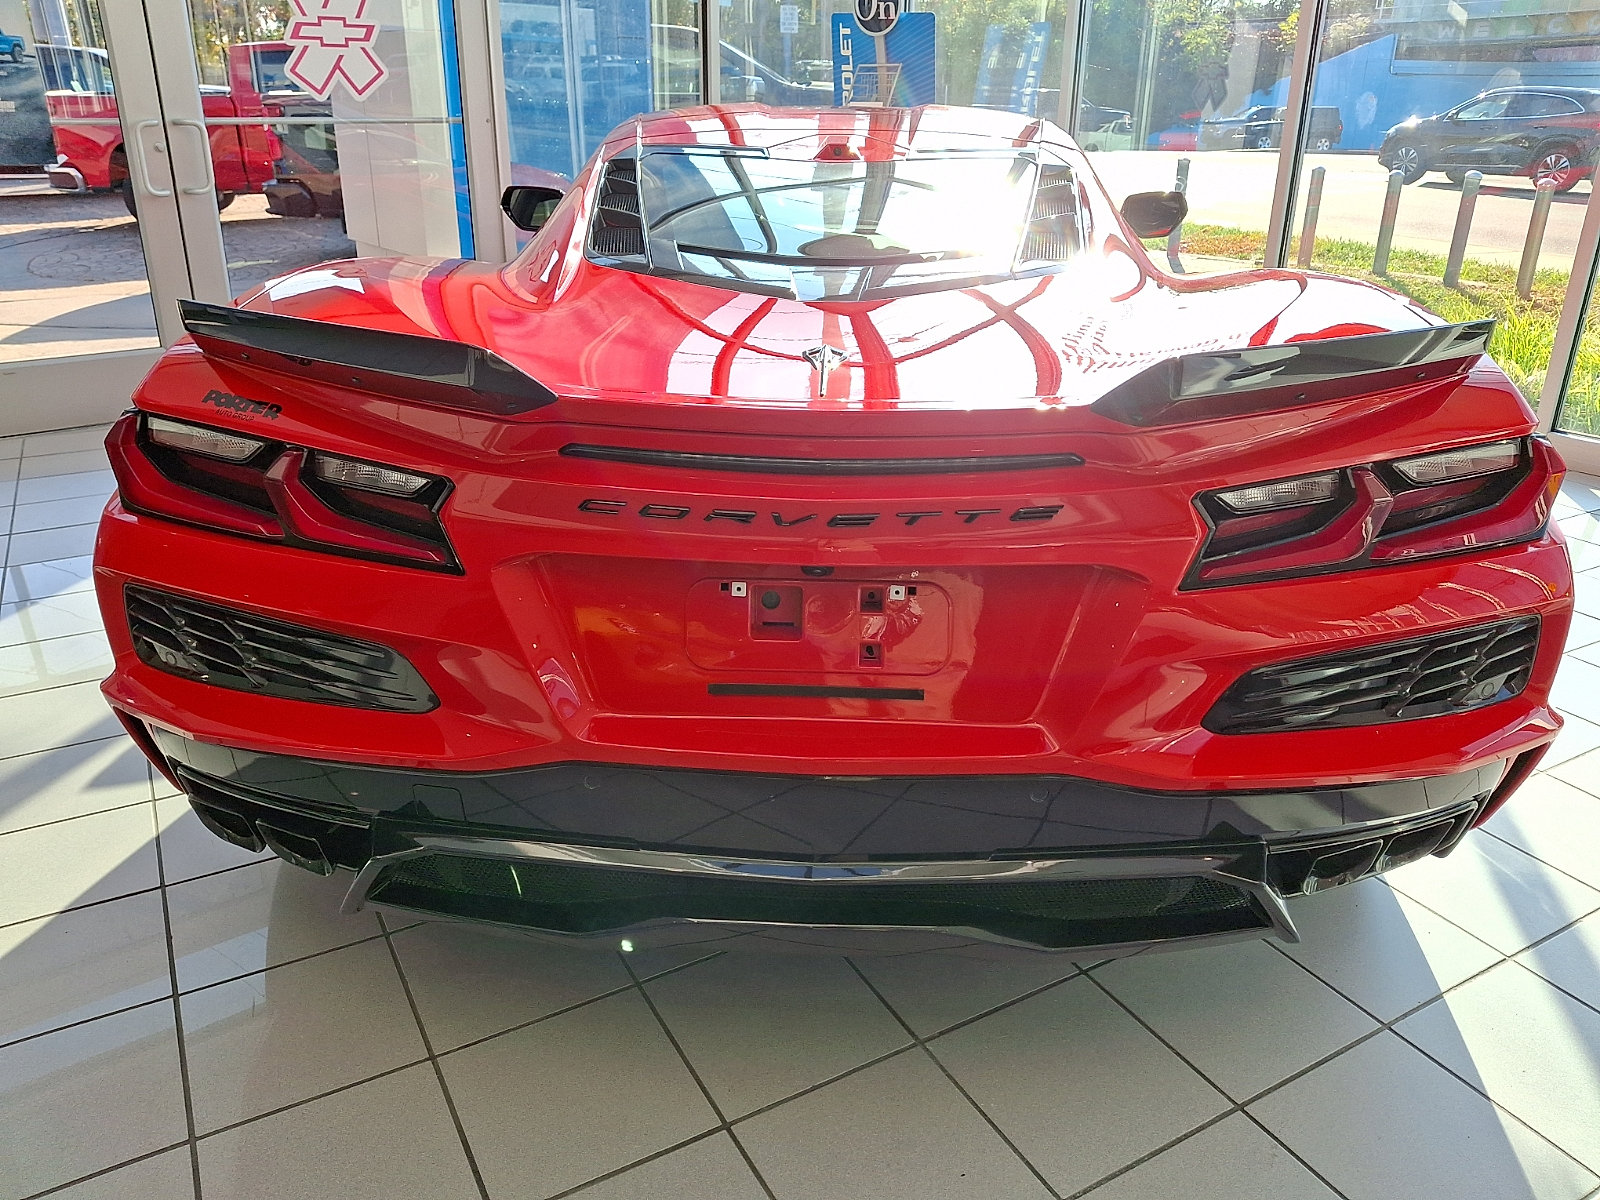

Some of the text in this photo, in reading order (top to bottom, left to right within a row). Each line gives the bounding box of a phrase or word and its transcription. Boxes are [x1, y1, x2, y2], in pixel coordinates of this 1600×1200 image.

[201, 389, 283, 420] PORTER
[216, 408, 255, 421] AUTO GROUP
[578, 498, 1065, 528] CORVETTE
